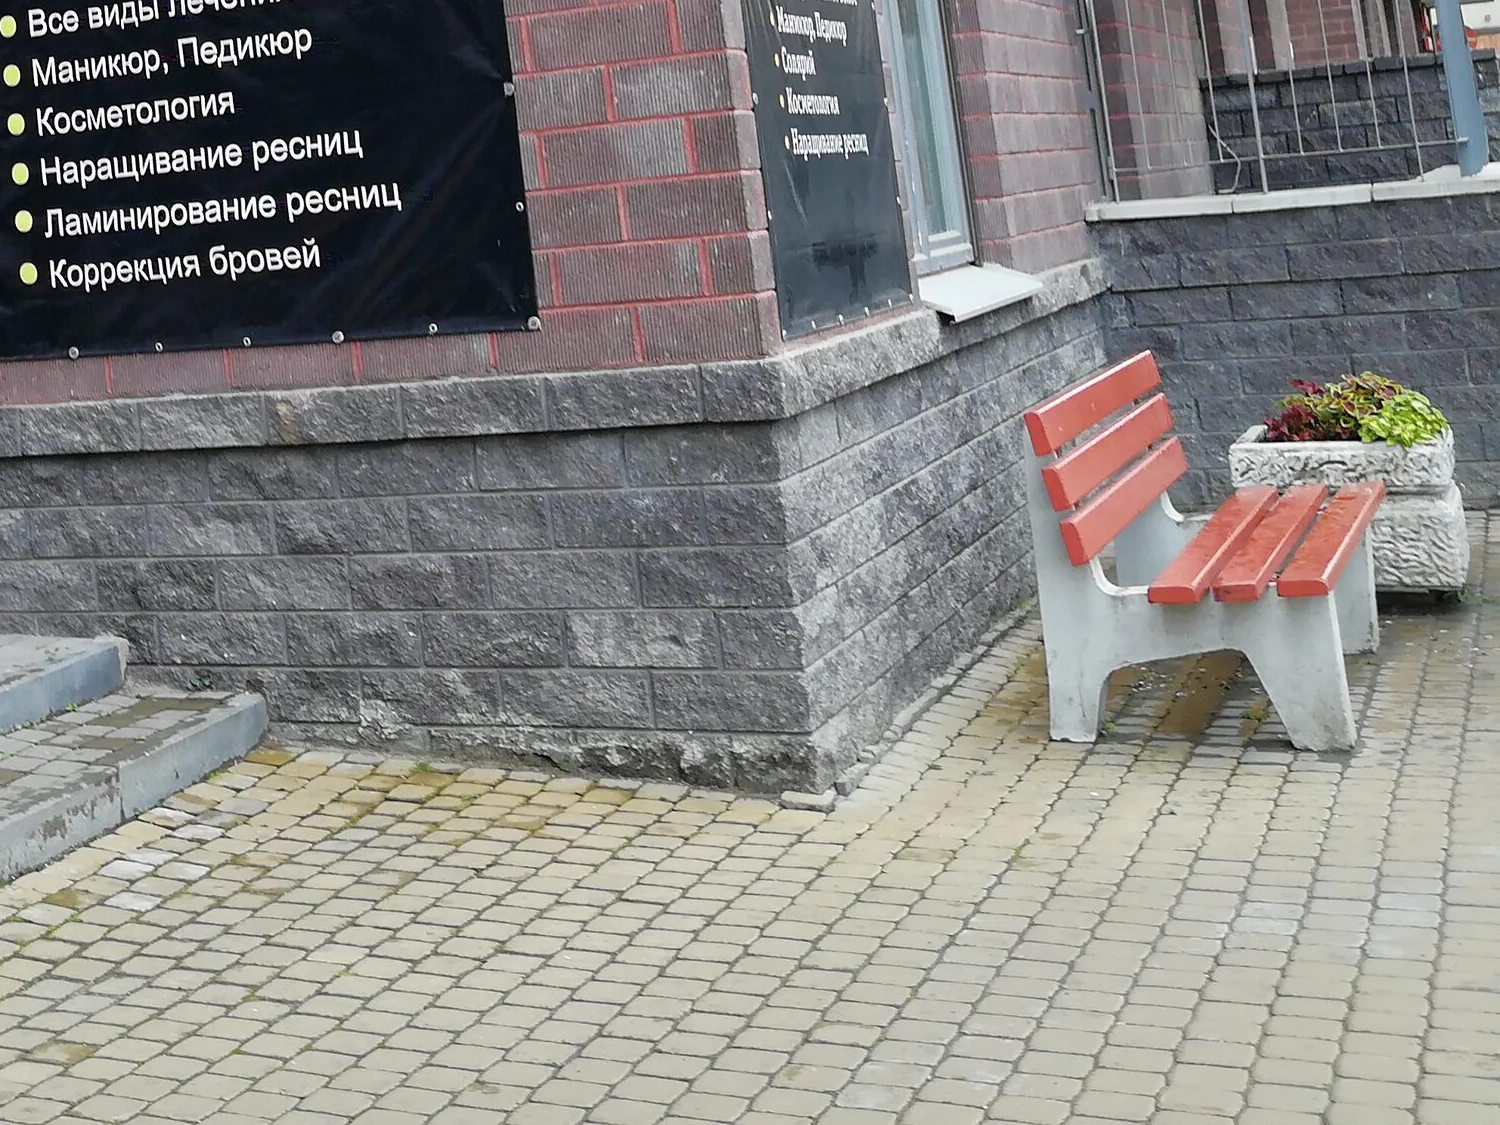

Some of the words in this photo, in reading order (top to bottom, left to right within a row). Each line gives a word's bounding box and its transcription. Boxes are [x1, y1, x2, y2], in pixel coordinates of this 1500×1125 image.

[27, 8, 80, 38] Все
[31, 49, 169, 87] Маникюр,
[177, 28, 313, 69] Педикюр
[36, 91, 235, 137] Косметология
[40, 144, 243, 189] Наращивание
[251, 129, 364, 168] ресниц
[44, 194, 277, 239] Ламинирование
[286, 182, 402, 223] ресниц
[49, 254, 201, 293] Коррекция
[208, 237, 321, 282] бровей
